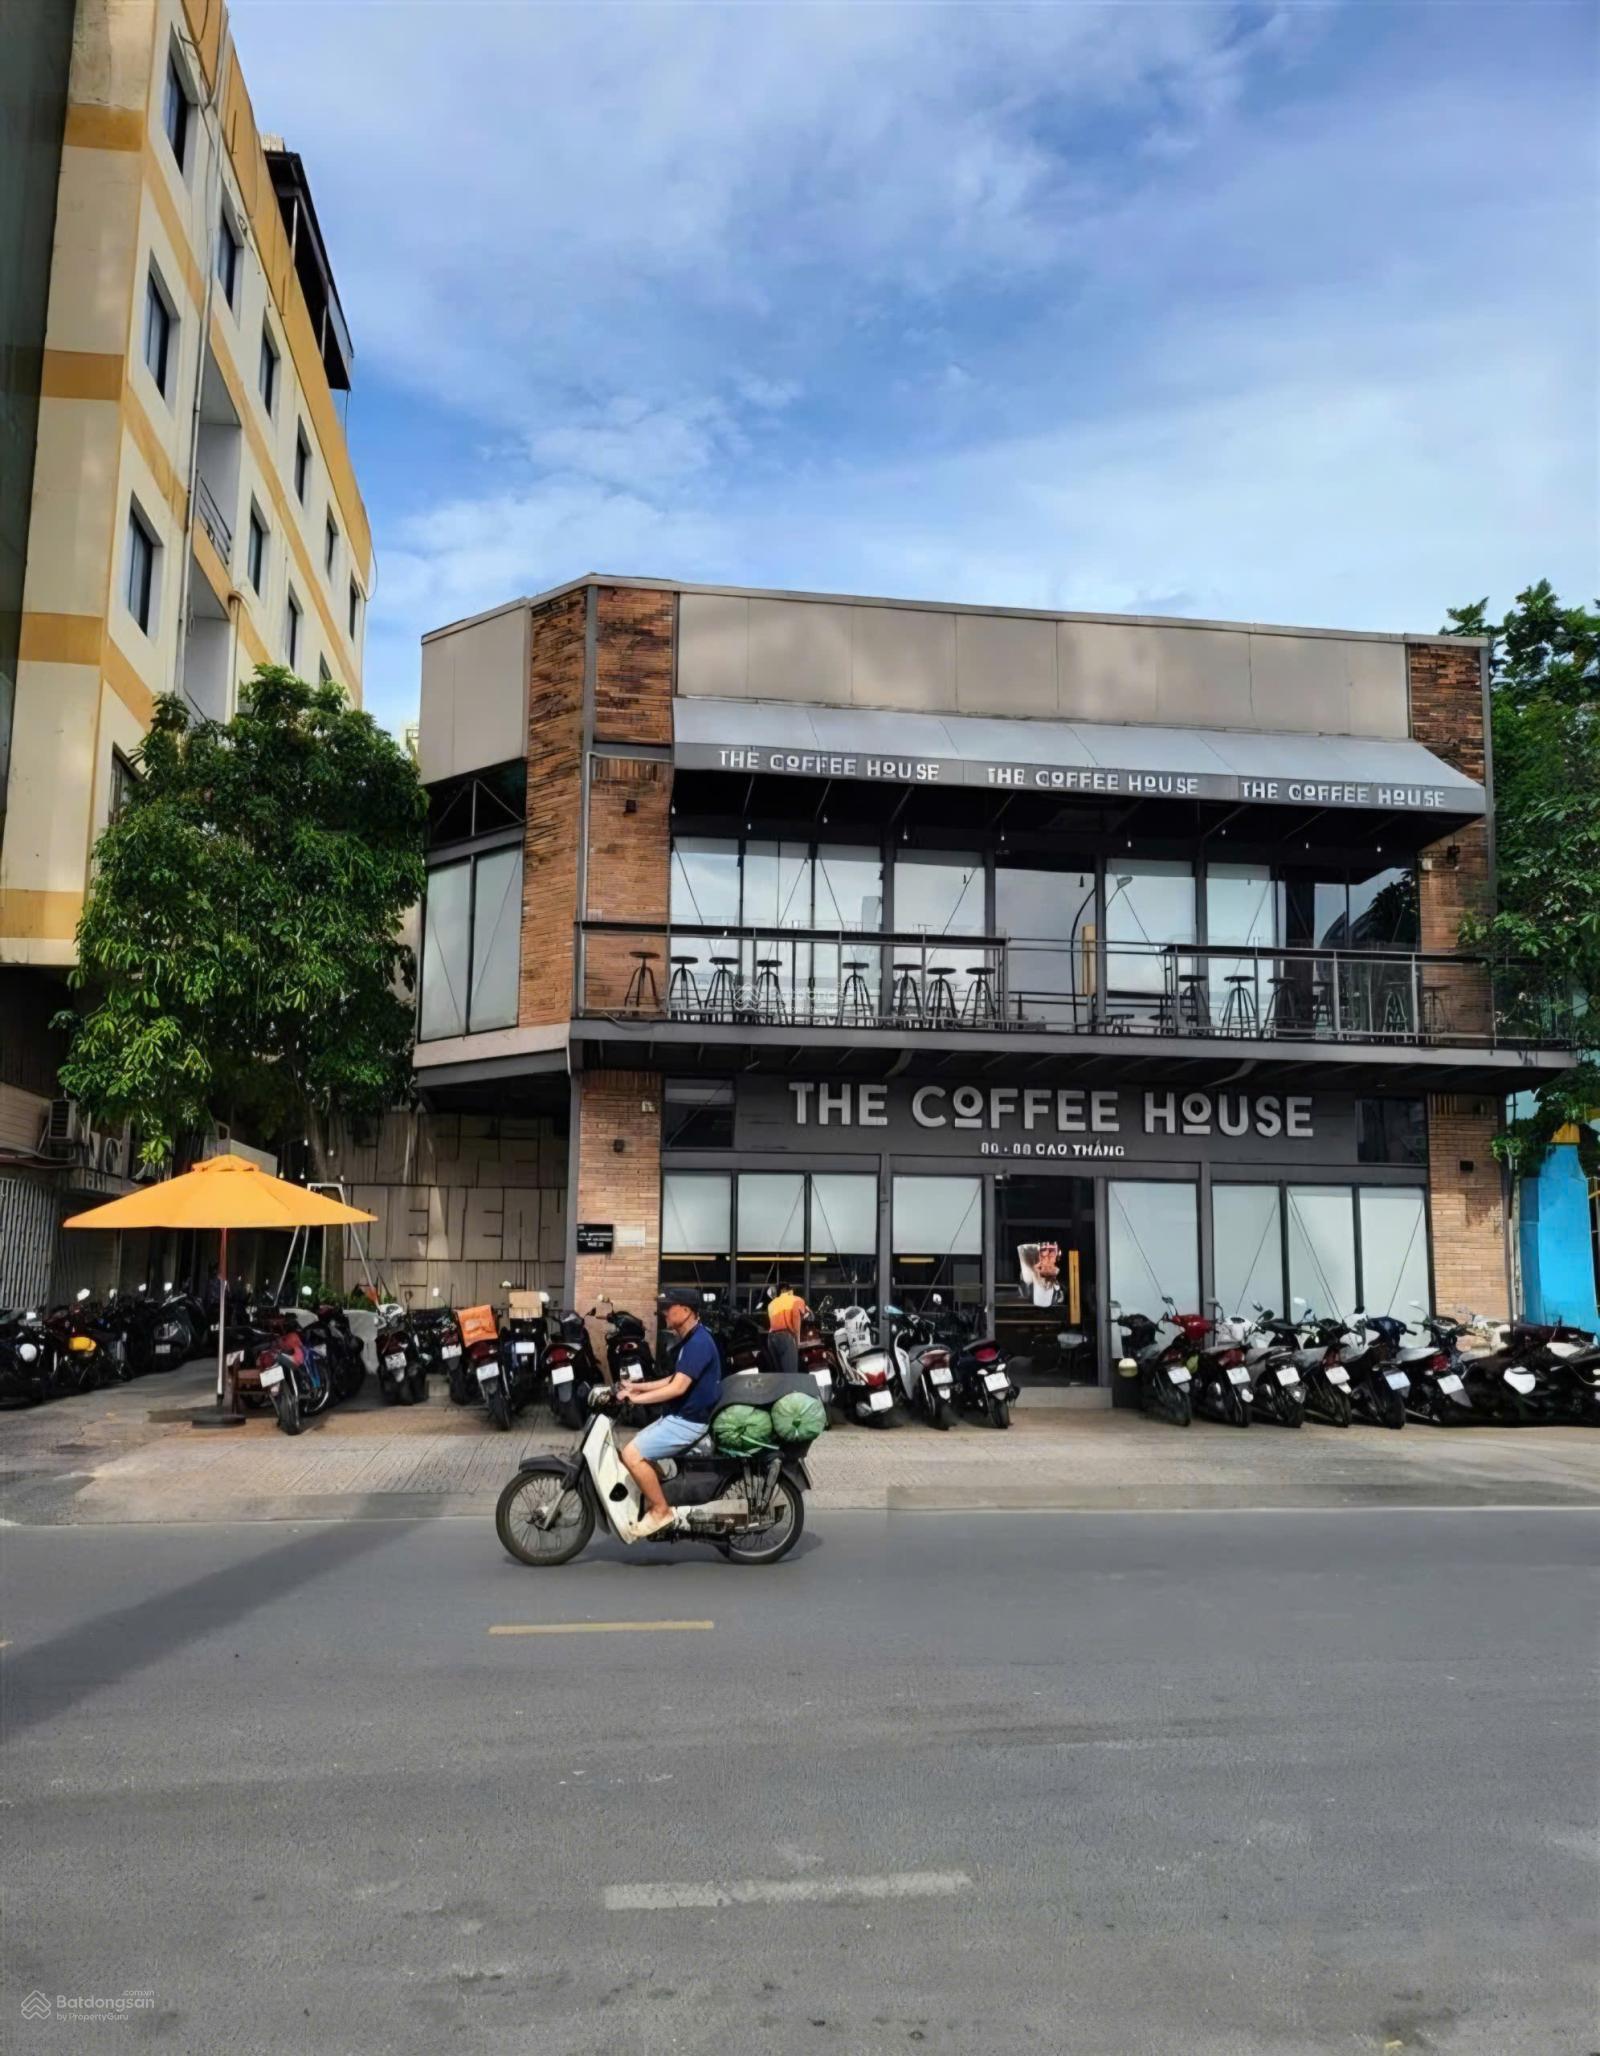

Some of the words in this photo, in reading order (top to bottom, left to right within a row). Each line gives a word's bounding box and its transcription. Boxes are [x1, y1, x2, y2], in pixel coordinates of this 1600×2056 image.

[719, 749, 760, 769] THE
[769, 754, 857, 776] COFFEE
[866, 759, 940, 781] HOUSE
[986, 766, 1025, 786] THE
[1035, 770, 1119, 791] COFFEE
[1128, 774, 1199, 795] HOUSE
[1241, 781, 1279, 799] THE
[1288, 783, 1370, 804] COFFEE
[1377, 787, 1445, 808] HOUSE
[788, 1081, 889, 1127] THE
[911, 1085, 1121, 1133] COFFEE
[1143, 1092, 1315, 1138] HOUSE
